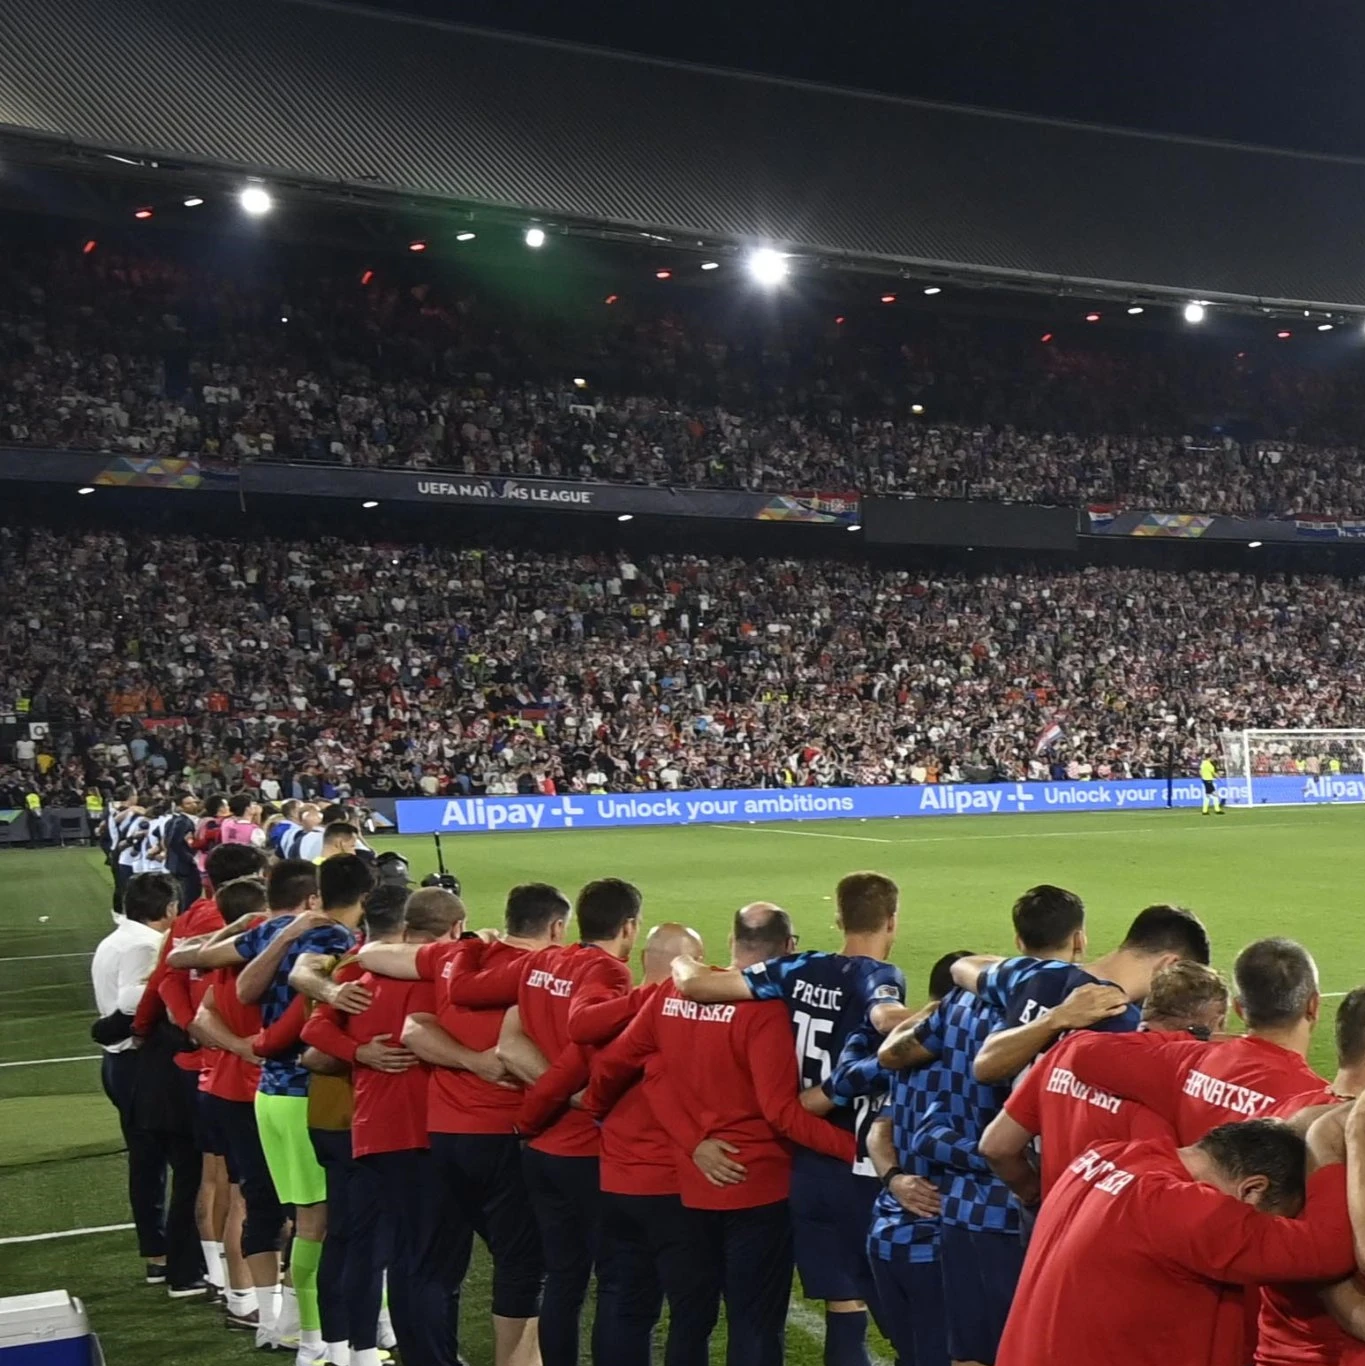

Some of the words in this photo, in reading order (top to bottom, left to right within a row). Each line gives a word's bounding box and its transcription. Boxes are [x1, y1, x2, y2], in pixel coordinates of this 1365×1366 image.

[417, 481, 458, 496] UEFA
[531, 487, 592, 504] LEAGUE
[599, 798, 681, 820] Unlock
[686, 800, 738, 820] your
[744, 793, 854, 814] ambitions
[1044, 786, 1111, 804] Unlock
[1115, 788, 1158, 805] your
[793, 1010, 835, 1088] 15
